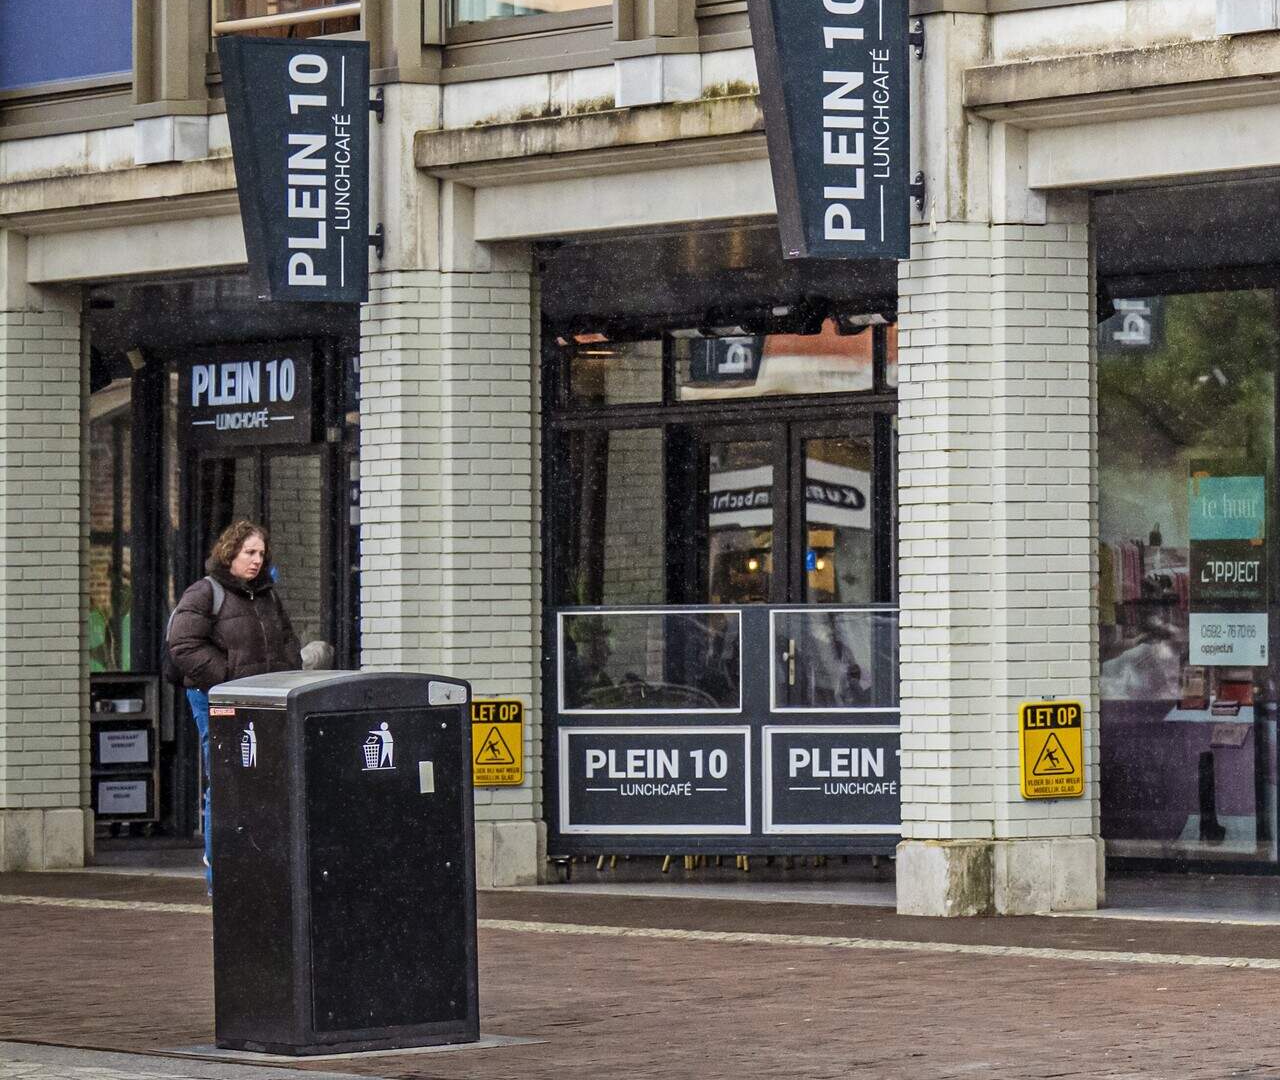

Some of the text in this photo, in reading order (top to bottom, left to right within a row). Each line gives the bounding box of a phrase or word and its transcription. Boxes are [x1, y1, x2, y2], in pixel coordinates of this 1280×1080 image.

[869, 48, 890, 178] LUNCHCAFÉ
[288, 53, 328, 287] PLEIN 10
[823, 71, 866, 241] PLEIN
[331, 114, 351, 230] LUNCHCAFÉ
[192, 358, 295, 407] PLEIN 10
[1202, 492, 1259, 518] te huur
[472, 704, 519, 721] LET OP
[1027, 707, 1077, 727] LET OP
[585, 748, 728, 779] PLEIN 10
[789, 747, 884, 777] PLEIN
[620, 782, 692, 796] LUNCHCAFÉ
[824, 781, 897, 795] LUNCHCAFÉ
